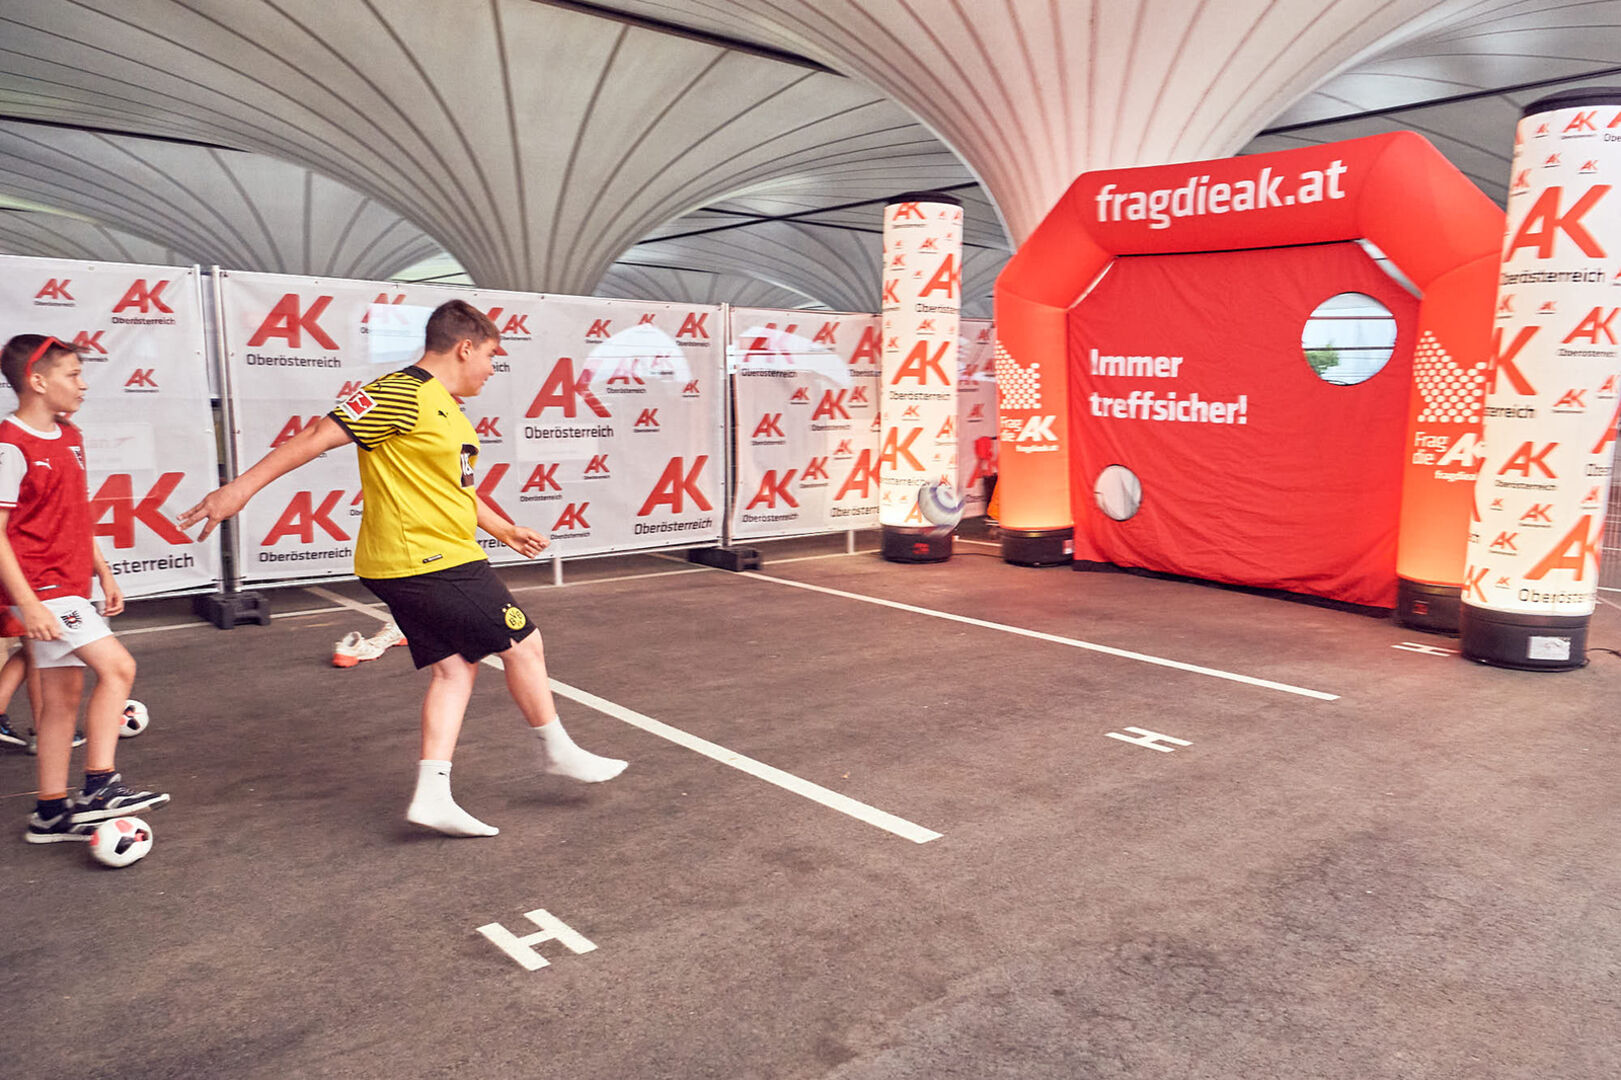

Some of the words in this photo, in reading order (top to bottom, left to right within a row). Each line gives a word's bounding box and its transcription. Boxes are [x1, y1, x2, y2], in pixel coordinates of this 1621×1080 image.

[1562, 110, 1598, 133] AK
[1580, 160, 1598, 170] AK
[1095, 160, 1348, 229] fragdieak.at
[893, 202, 926, 221] AK
[1502, 184, 1613, 263] AK
[34, 278, 75, 300] AK
[112, 278, 174, 313] AK
[246, 293, 340, 350] AK
[501, 314, 531, 334] AK
[585, 319, 612, 338] AK
[676, 312, 709, 338] AK
[812, 321, 840, 344] AK
[1561, 306, 1621, 345] AK
[246, 353, 341, 368] Oberösterreich
[891, 340, 951, 386] AK
[124, 368, 159, 387] AK
[525, 357, 612, 418] AK
[790, 387, 810, 401] AK
[811, 389, 851, 420] AK
[849, 386, 868, 402] AK
[1553, 389, 1587, 408] AK
[634, 408, 660, 427] AK
[1088, 390, 1248, 425] treffsicher!
[475, 417, 502, 437] AK
[525, 425, 614, 439] Oberösterreich
[752, 413, 785, 438] AK
[1016, 415, 1058, 441] AK
[833, 439, 853, 455] AK
[880, 426, 926, 471] AK
[1414, 431, 1449, 452] Frag
[584, 454, 610, 474] AK
[801, 456, 829, 480] AK
[1497, 441, 1560, 479] AK
[520, 463, 562, 492] AK
[636, 455, 713, 517] AK
[475, 463, 516, 525] K
[745, 469, 800, 510] AK
[91, 472, 194, 549] AK
[260, 490, 351, 546] AK
[552, 502, 590, 531] AK
[904, 500, 922, 523] A
[1519, 503, 1553, 522] AK
[634, 518, 713, 535] Oberösterreich
[1490, 531, 1519, 550] AK
[106, 553, 194, 576] sterreich
[259, 547, 352, 562] Oberösterreich
[1390, 642, 1461, 657] H
[1104, 726, 1193, 752] H
[476, 908, 599, 971] H
